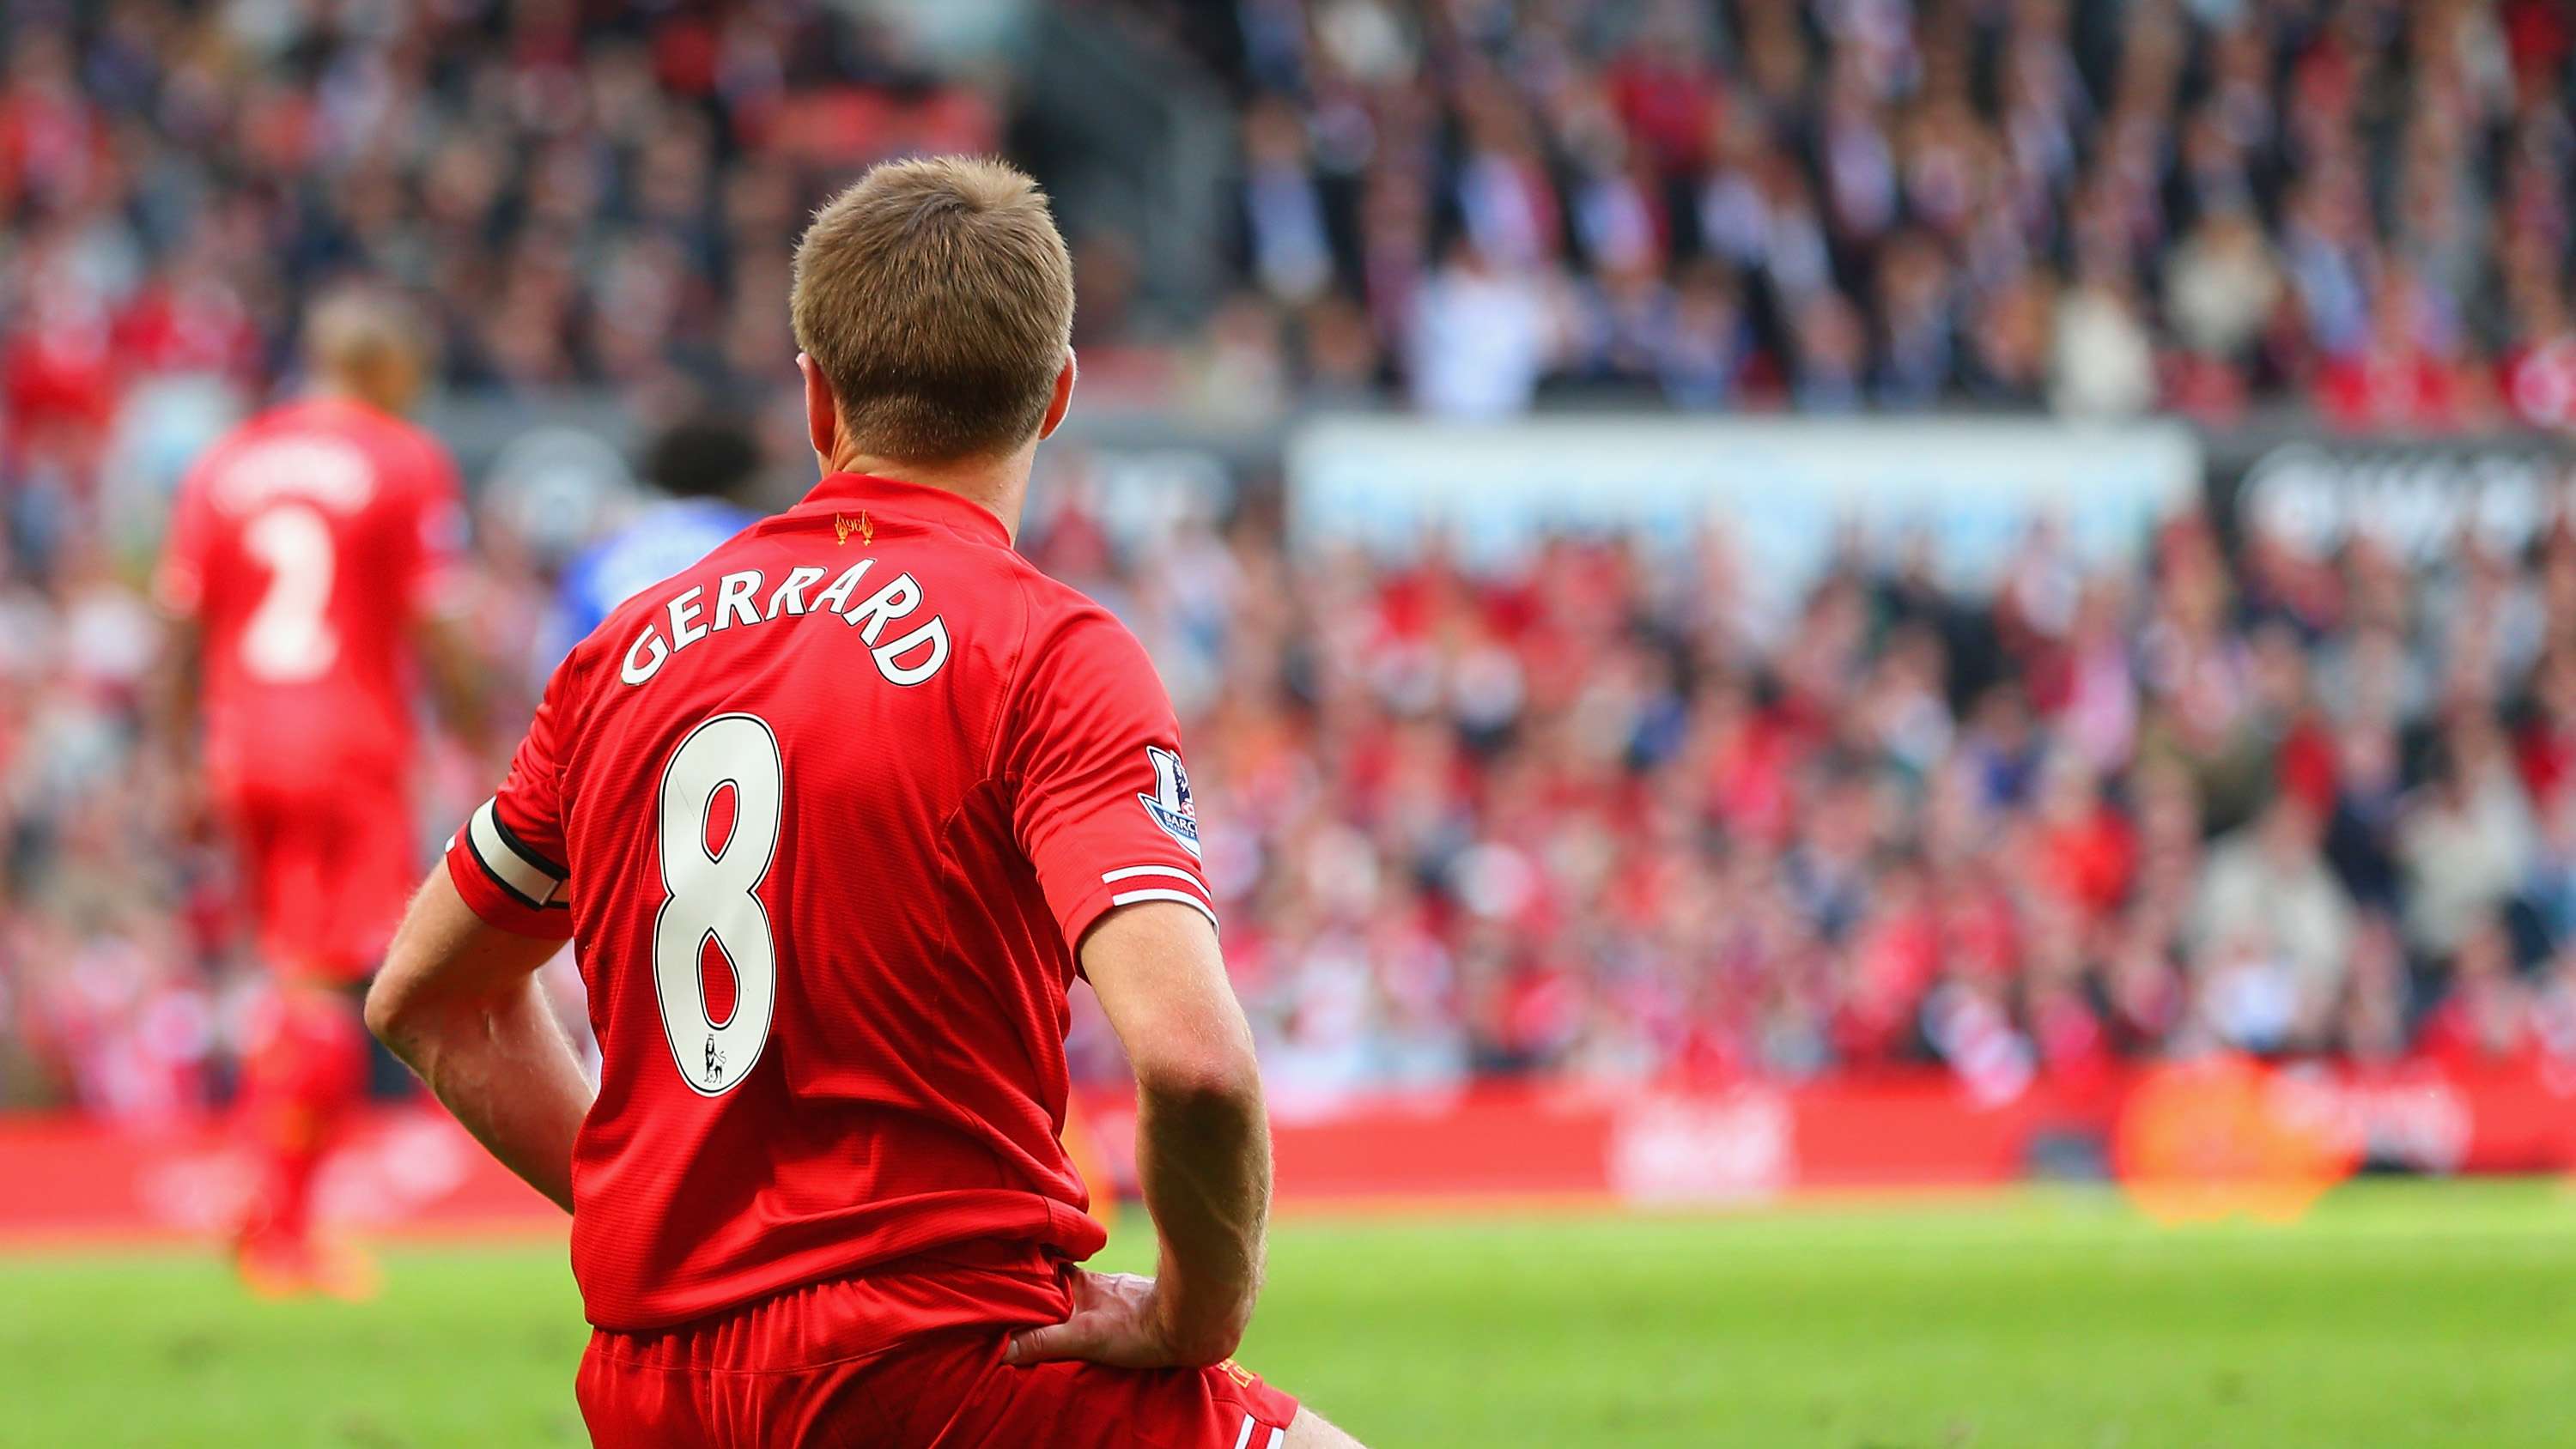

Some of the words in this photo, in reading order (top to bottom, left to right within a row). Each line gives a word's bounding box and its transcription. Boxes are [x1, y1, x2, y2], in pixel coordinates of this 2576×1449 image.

[242, 503, 339, 683] 2
[620, 558, 951, 687] GERRARD
[653, 712, 783, 1097] 8
